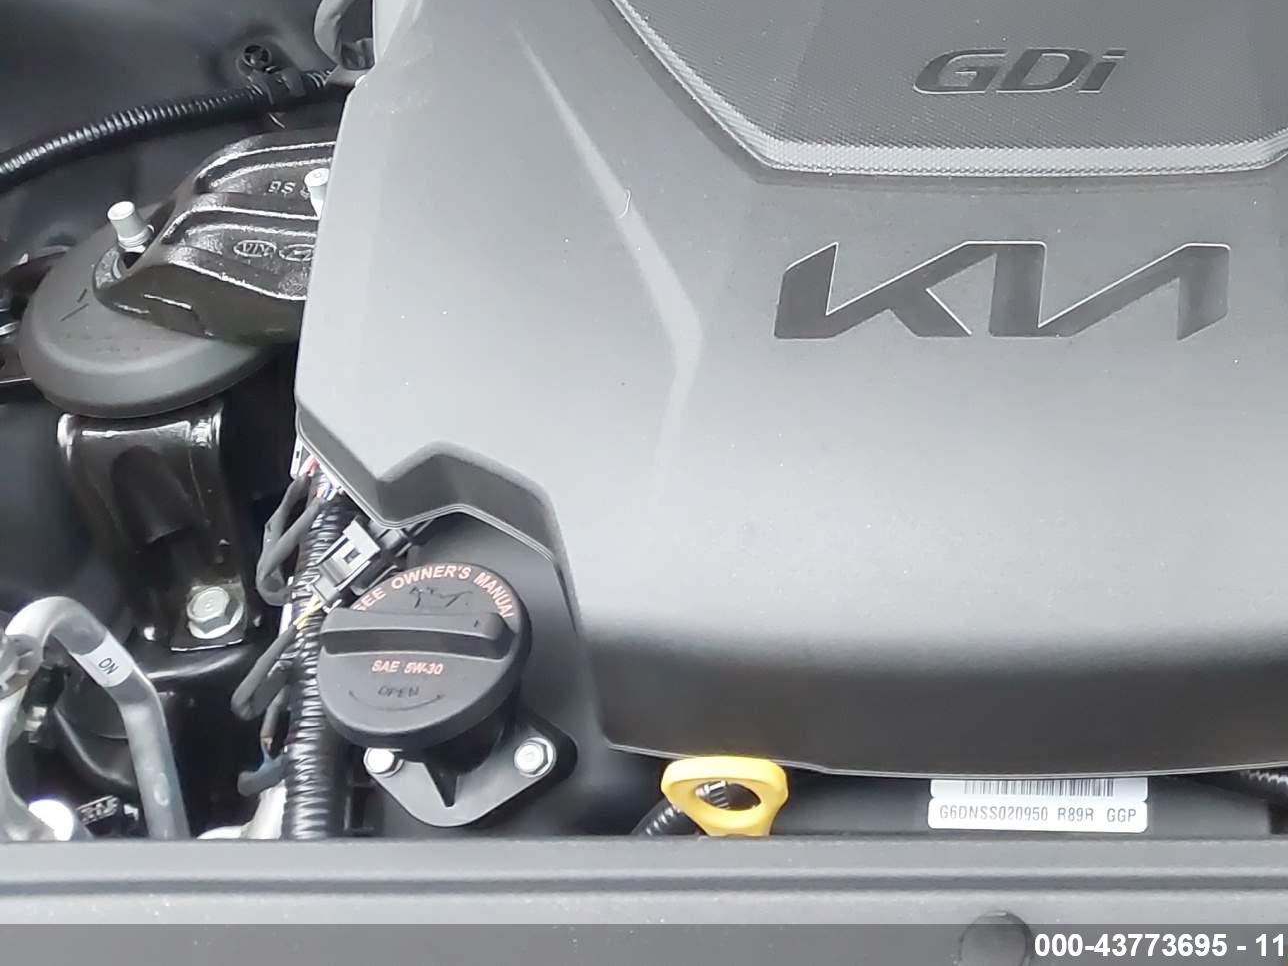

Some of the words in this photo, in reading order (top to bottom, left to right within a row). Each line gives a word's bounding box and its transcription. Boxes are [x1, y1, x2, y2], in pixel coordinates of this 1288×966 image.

[912, 47, 1129, 94] GDi
[773, 240, 1231, 341] KIA
[391, 564, 472, 590] OWNER'S
[371, 660, 401, 673] SAE
[404, 662, 445, 675] 5W-30
[377, 686, 420, 698] OPEN
[1106, 807, 1137, 823] GGP
